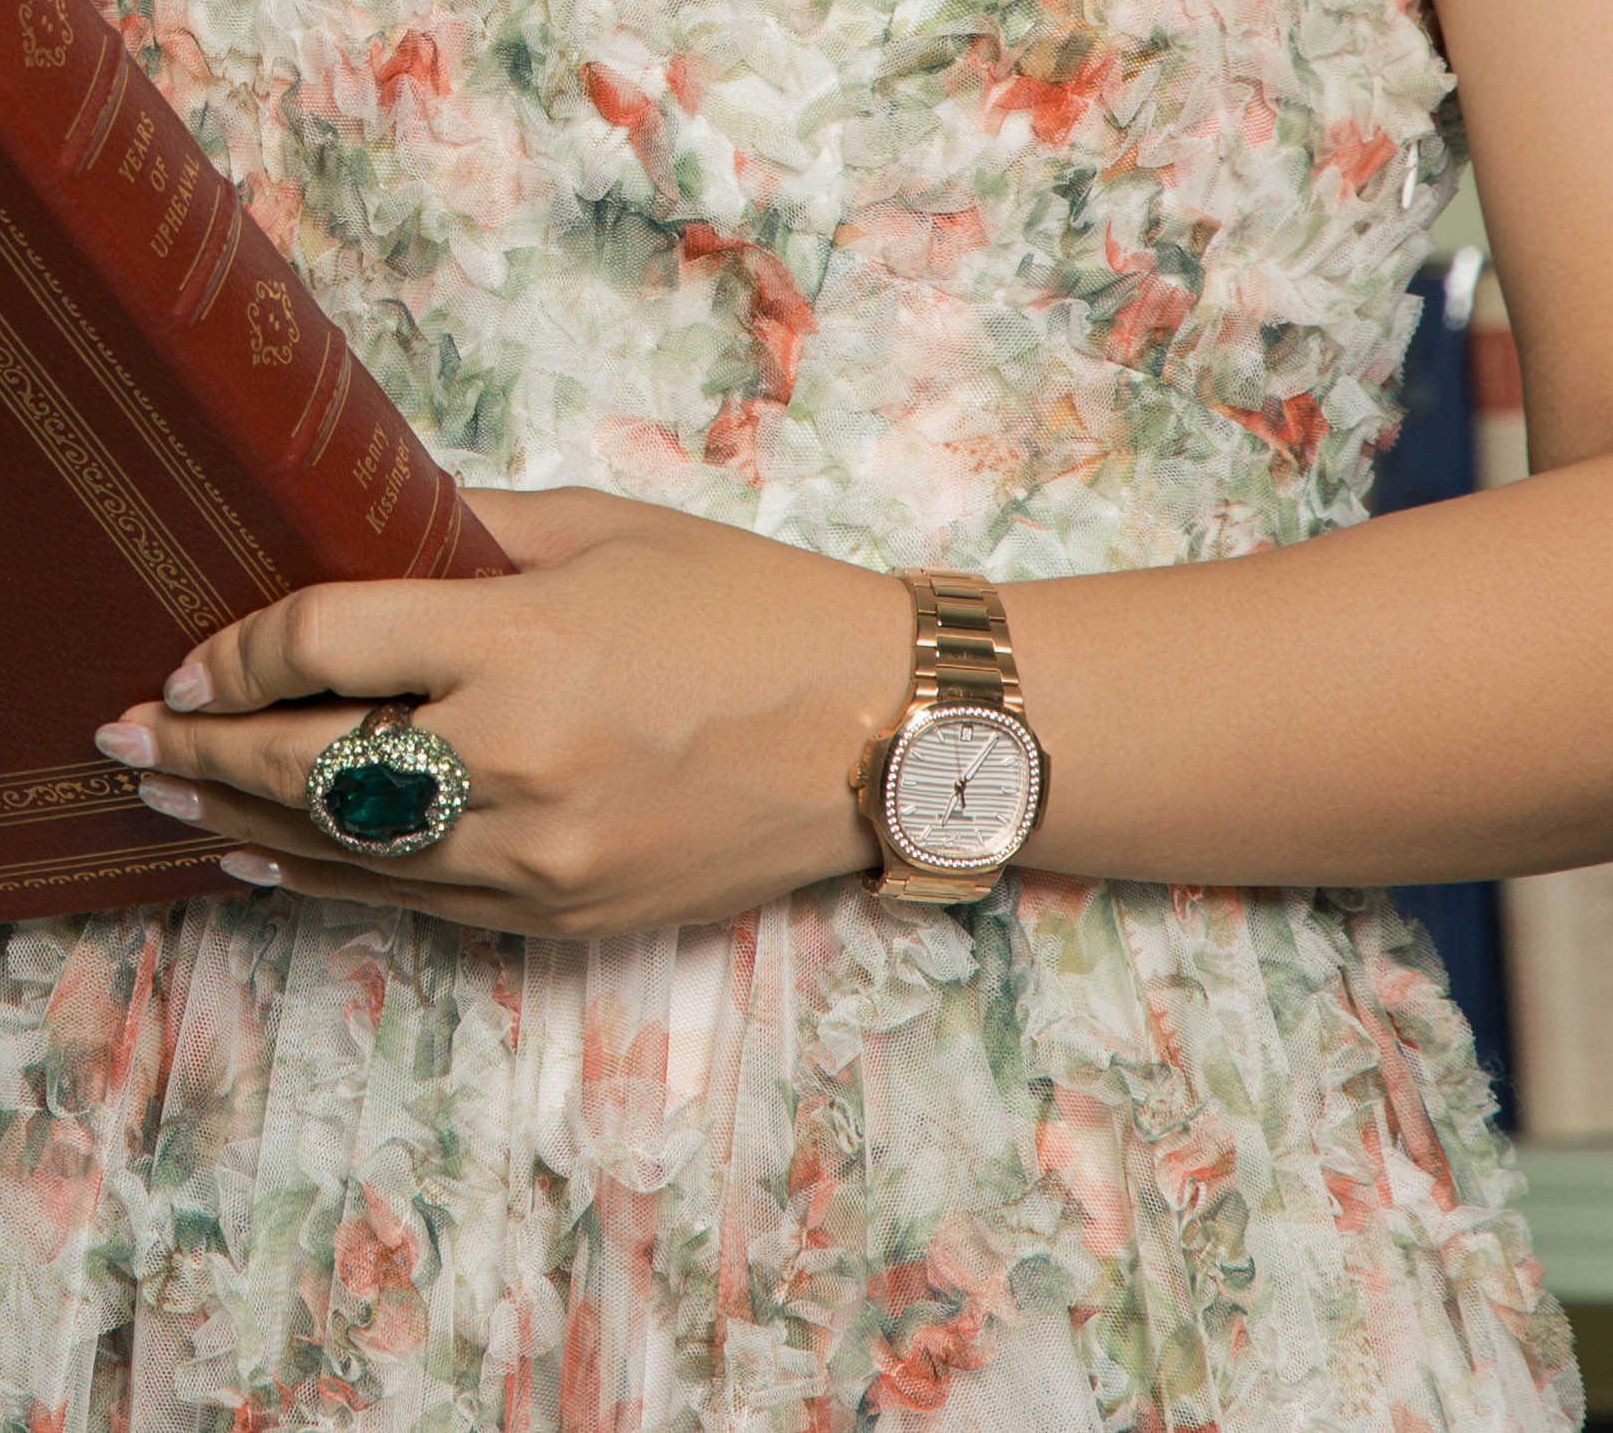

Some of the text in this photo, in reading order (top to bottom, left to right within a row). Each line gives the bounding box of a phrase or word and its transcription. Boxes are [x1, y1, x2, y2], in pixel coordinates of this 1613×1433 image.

[118, 111, 156, 185] YEARS
[150, 155, 170, 193] OF
[150, 152, 201, 259] UPHEAVAL
[351, 422, 392, 490] Henry
[365, 435, 413, 535] Kissinger
